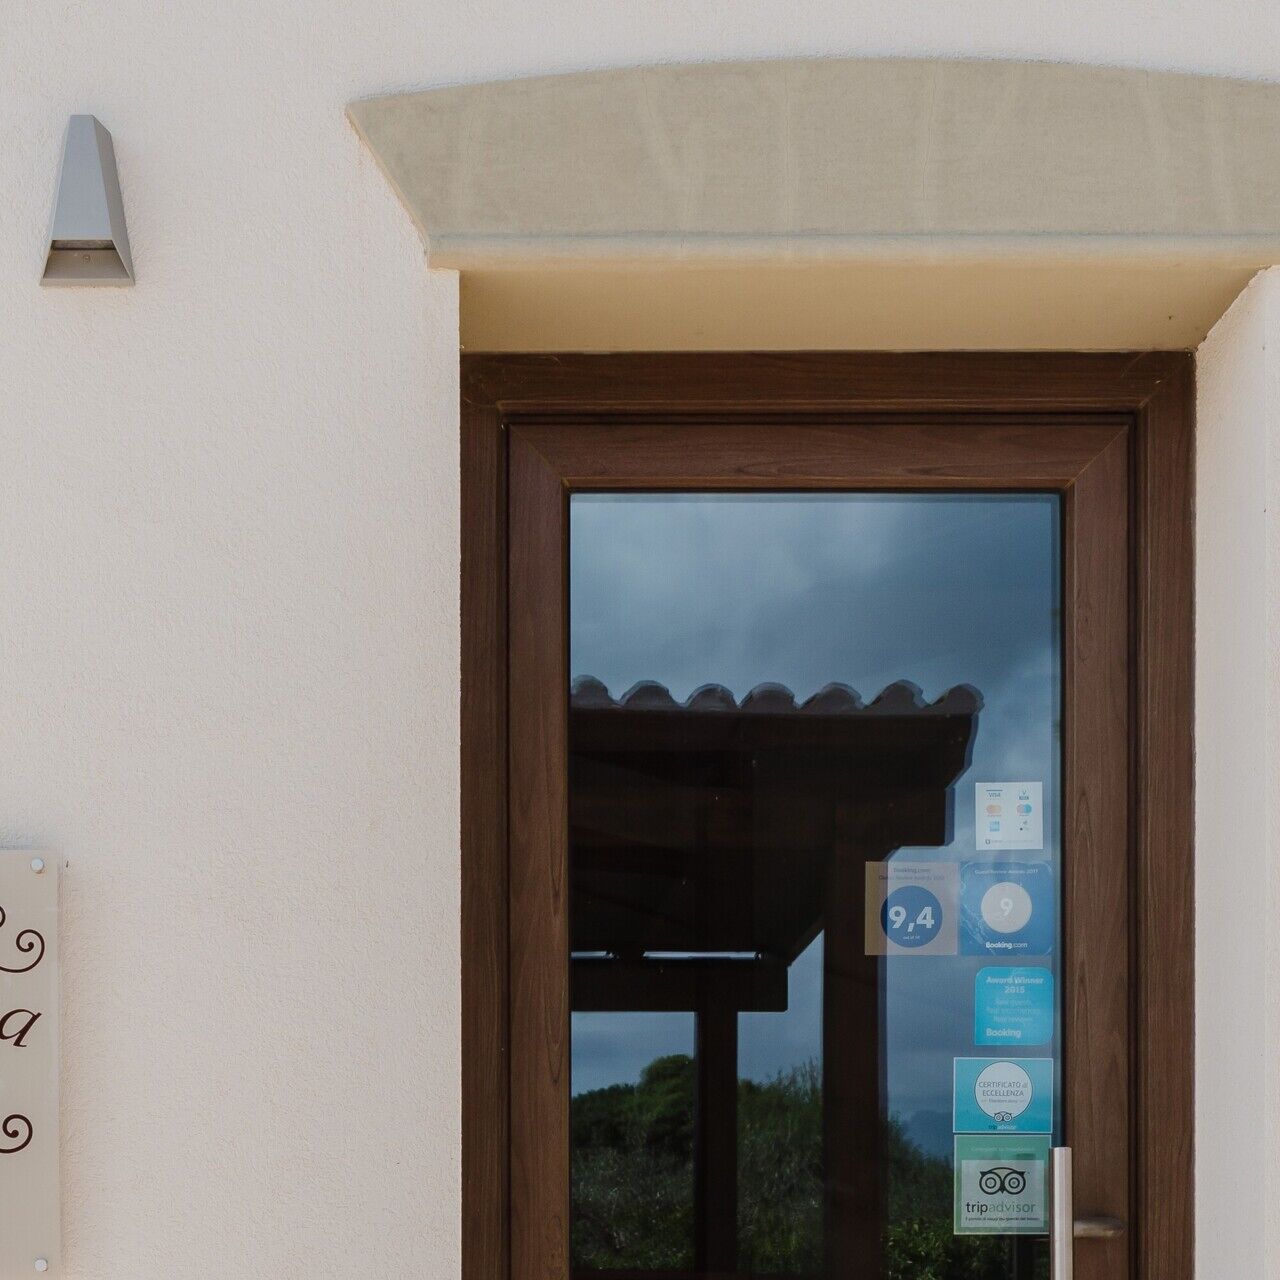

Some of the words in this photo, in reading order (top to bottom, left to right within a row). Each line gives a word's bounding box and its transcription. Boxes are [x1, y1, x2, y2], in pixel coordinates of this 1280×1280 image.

[1000, 898, 1013, 916] 9
[888, 906, 934, 932] 9,4
[985, 941, 1028, 950] Booking.com
[986, 1029, 1022, 1039] Booking
[965, 1201, 1036, 1215] tripadvisor
